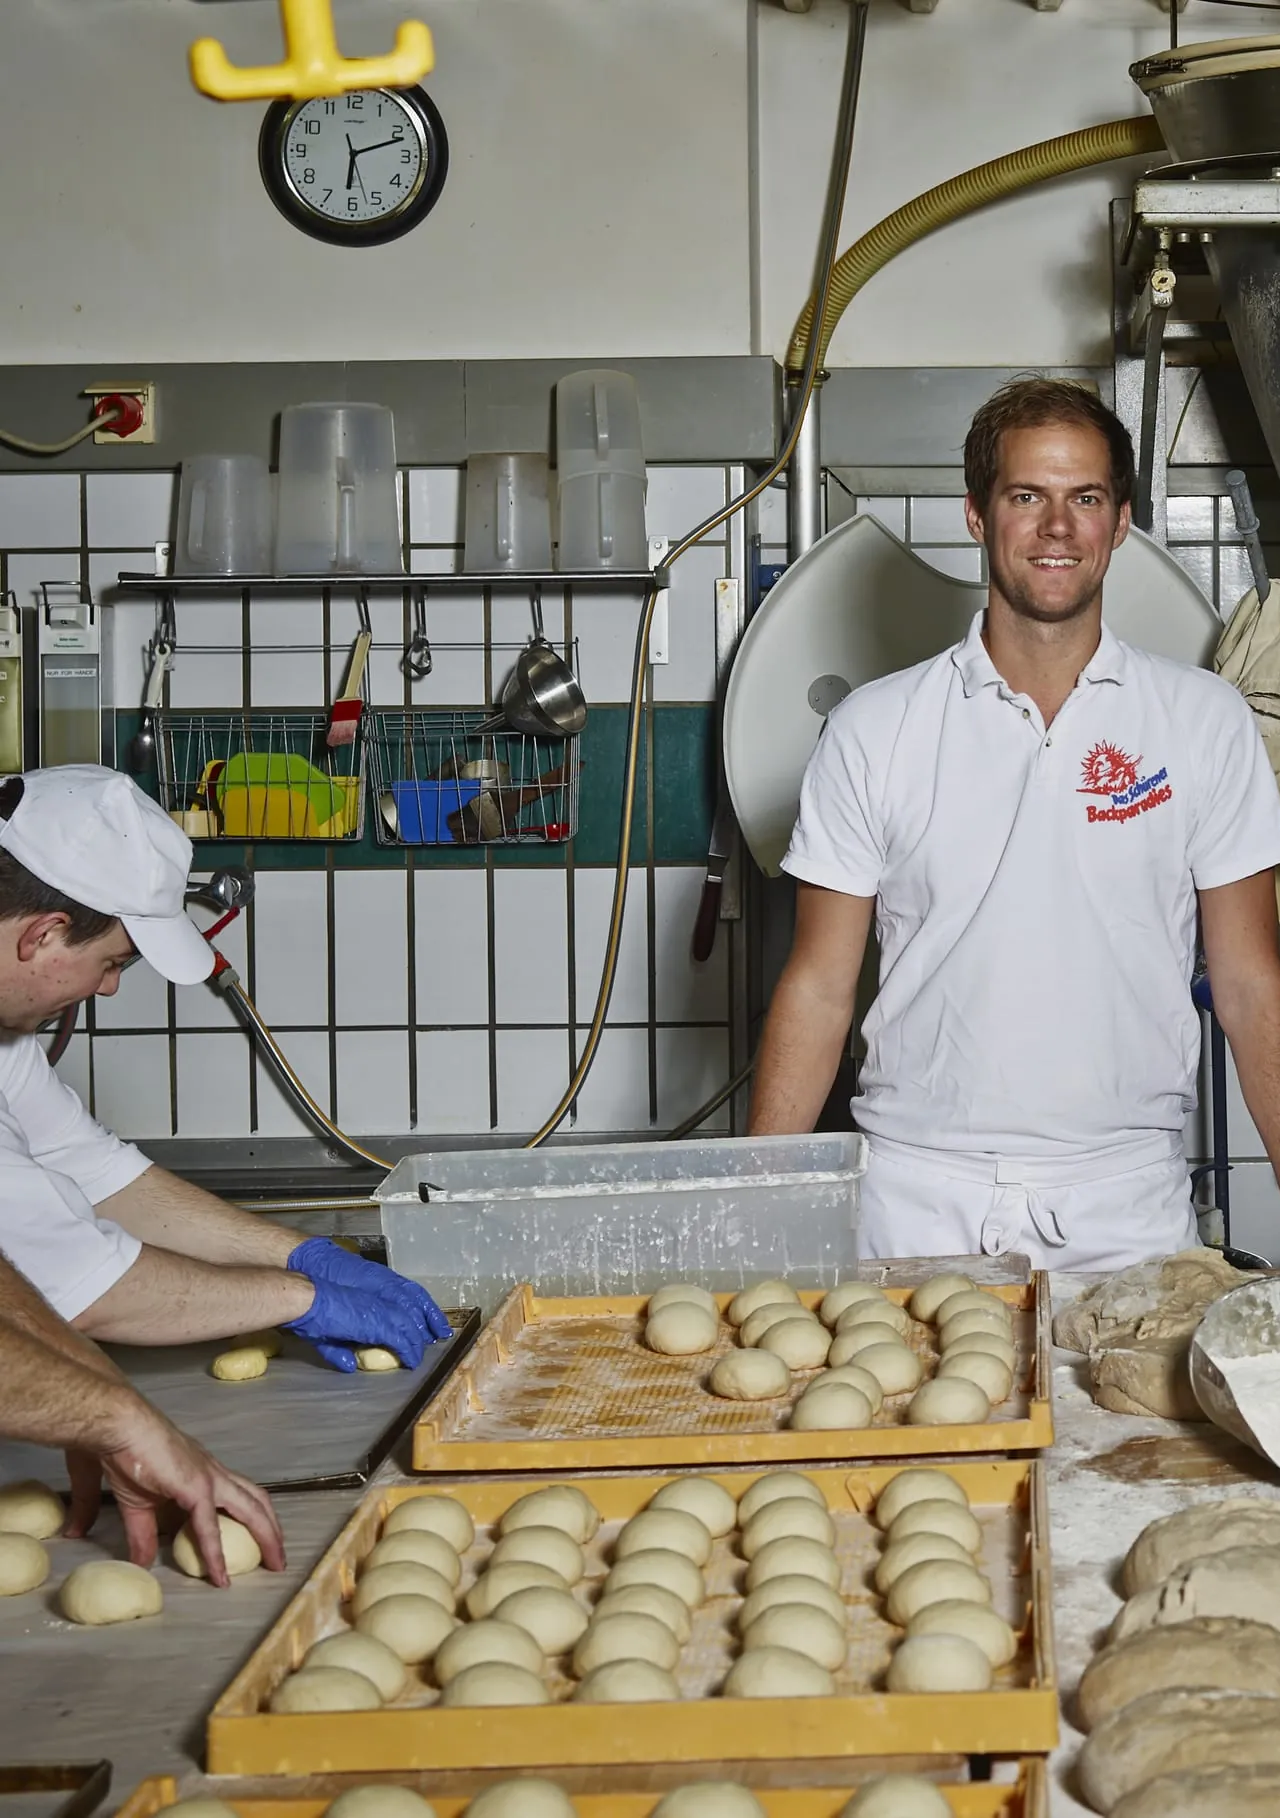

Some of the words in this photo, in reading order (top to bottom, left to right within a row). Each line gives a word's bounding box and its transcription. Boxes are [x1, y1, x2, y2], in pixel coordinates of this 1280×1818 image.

[324, 101, 335, 115] 11
[346, 95, 364, 109] 12
[376, 104, 382, 117] 1
[303, 120, 321, 135] 10
[391, 125, 404, 140] 2
[295, 143, 306, 158] 9
[400, 149, 411, 164] 3
[303, 168, 315, 184] 8
[389, 173, 402, 188] 4
[322, 188, 333, 203] 7
[370, 191, 382, 206] 5
[347, 197, 358, 211] 6
